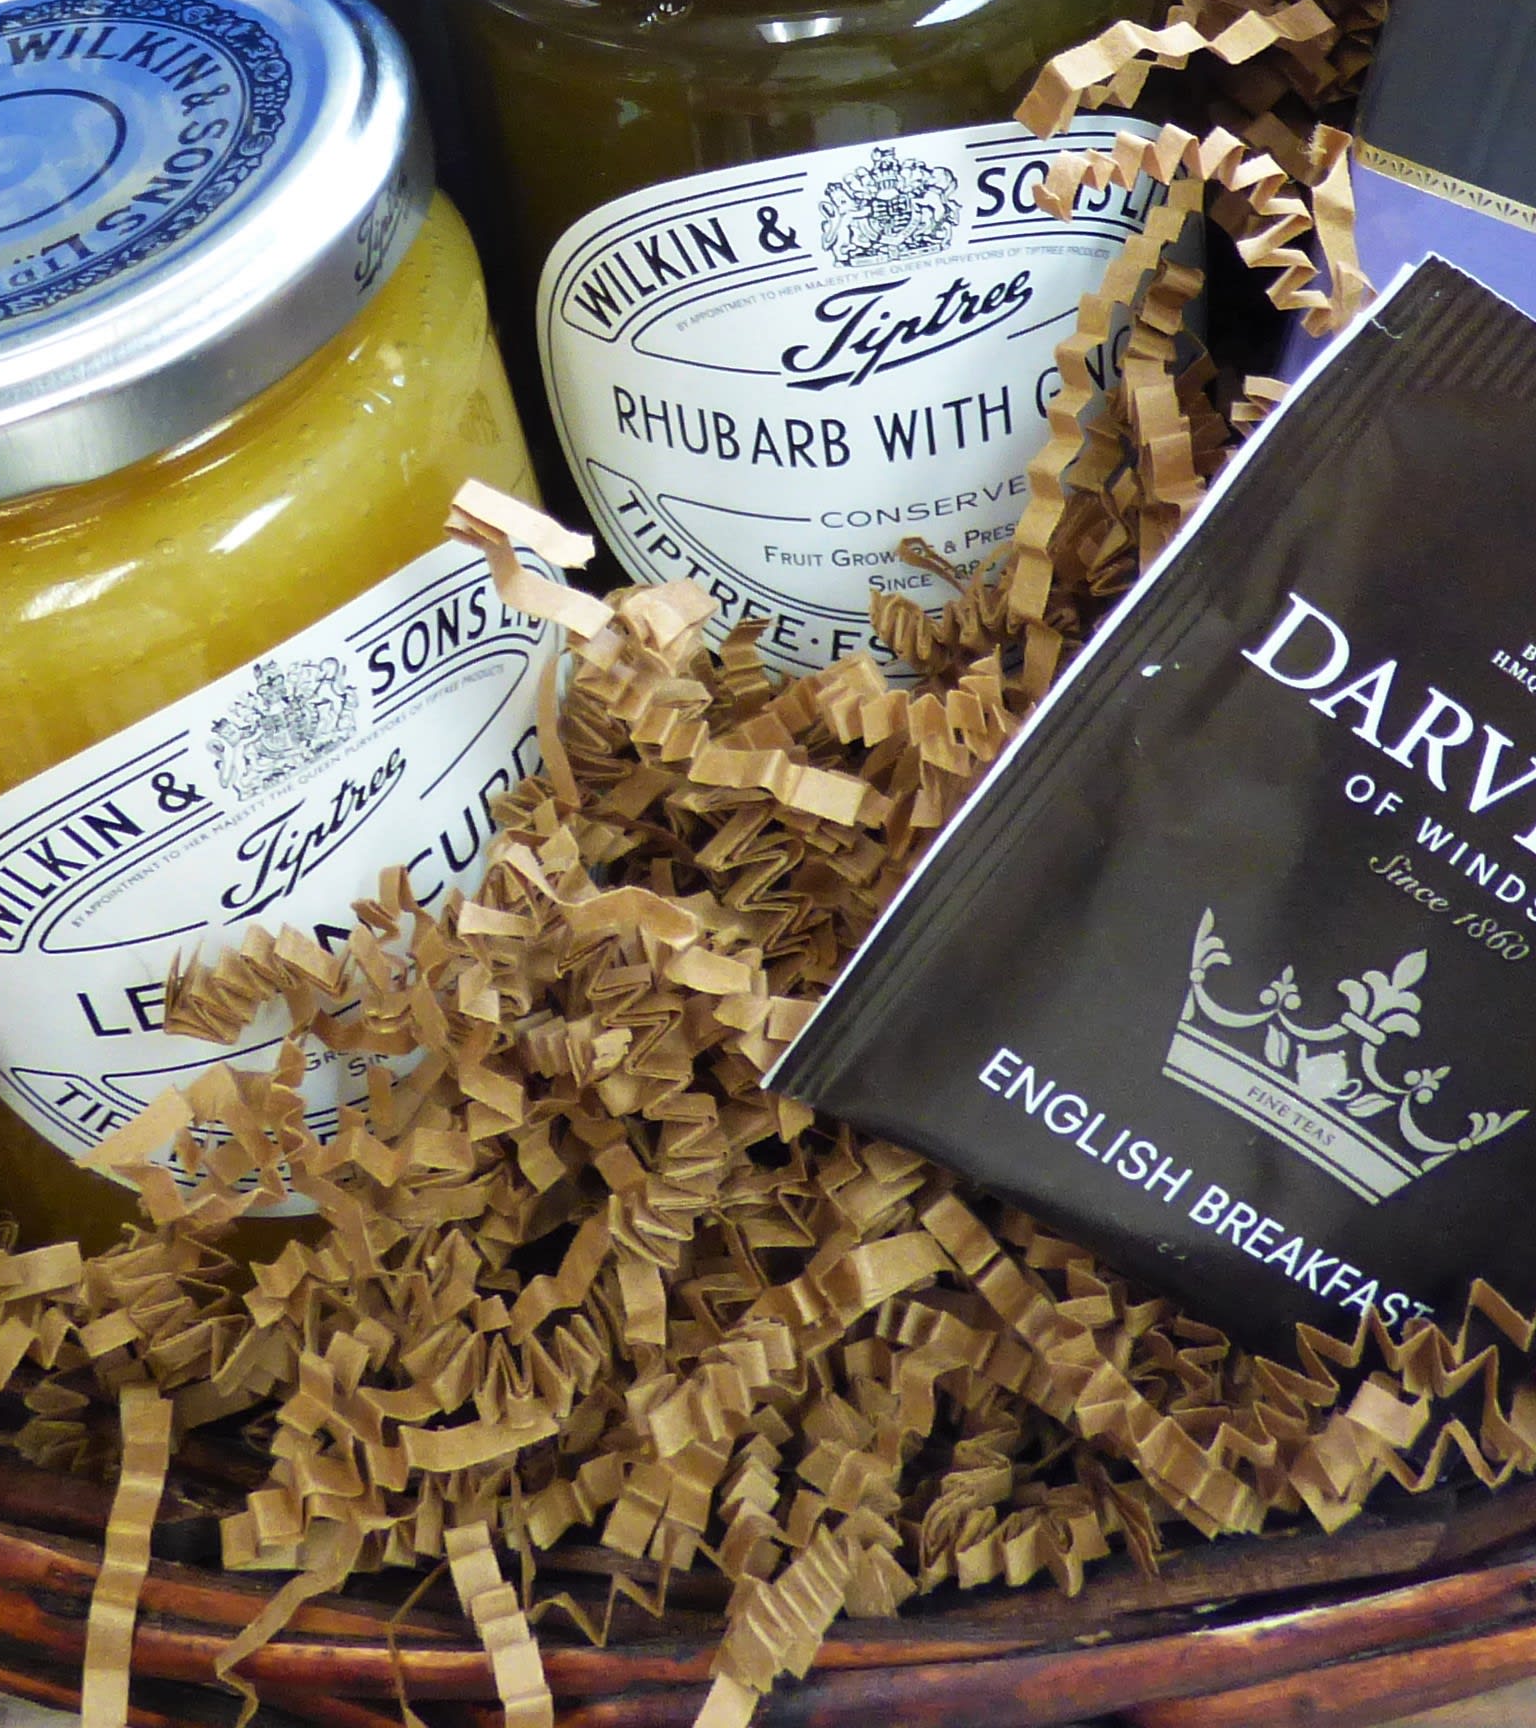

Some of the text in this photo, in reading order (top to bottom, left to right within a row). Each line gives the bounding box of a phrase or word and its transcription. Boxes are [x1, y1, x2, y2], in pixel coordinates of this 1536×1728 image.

[7, 24, 223, 93] WILKIN
[180, 76, 231, 118] &
[94, 117, 231, 239] SONS
[573, 205, 805, 329] WILKIN &
[781, 268, 1032, 391] Tiptree
[613, 384, 1013, 470] RHUBARB WITH
[820, 474, 1028, 530] CONSERVE
[943, 539, 957, 555] &
[152, 772, 206, 814] &
[367, 584, 487, 698] SONS
[221, 746, 408, 927] Tiptree
[1344, 773, 1404, 817] OF
[86, 863, 163, 921] APPOINTMENT
[162, 846, 182, 865] TO
[1368, 853, 1530, 962] Since 1860
[977, 1046, 1194, 1204] ENGLISH
[1247, 1083, 1339, 1149] FINE TEAS
